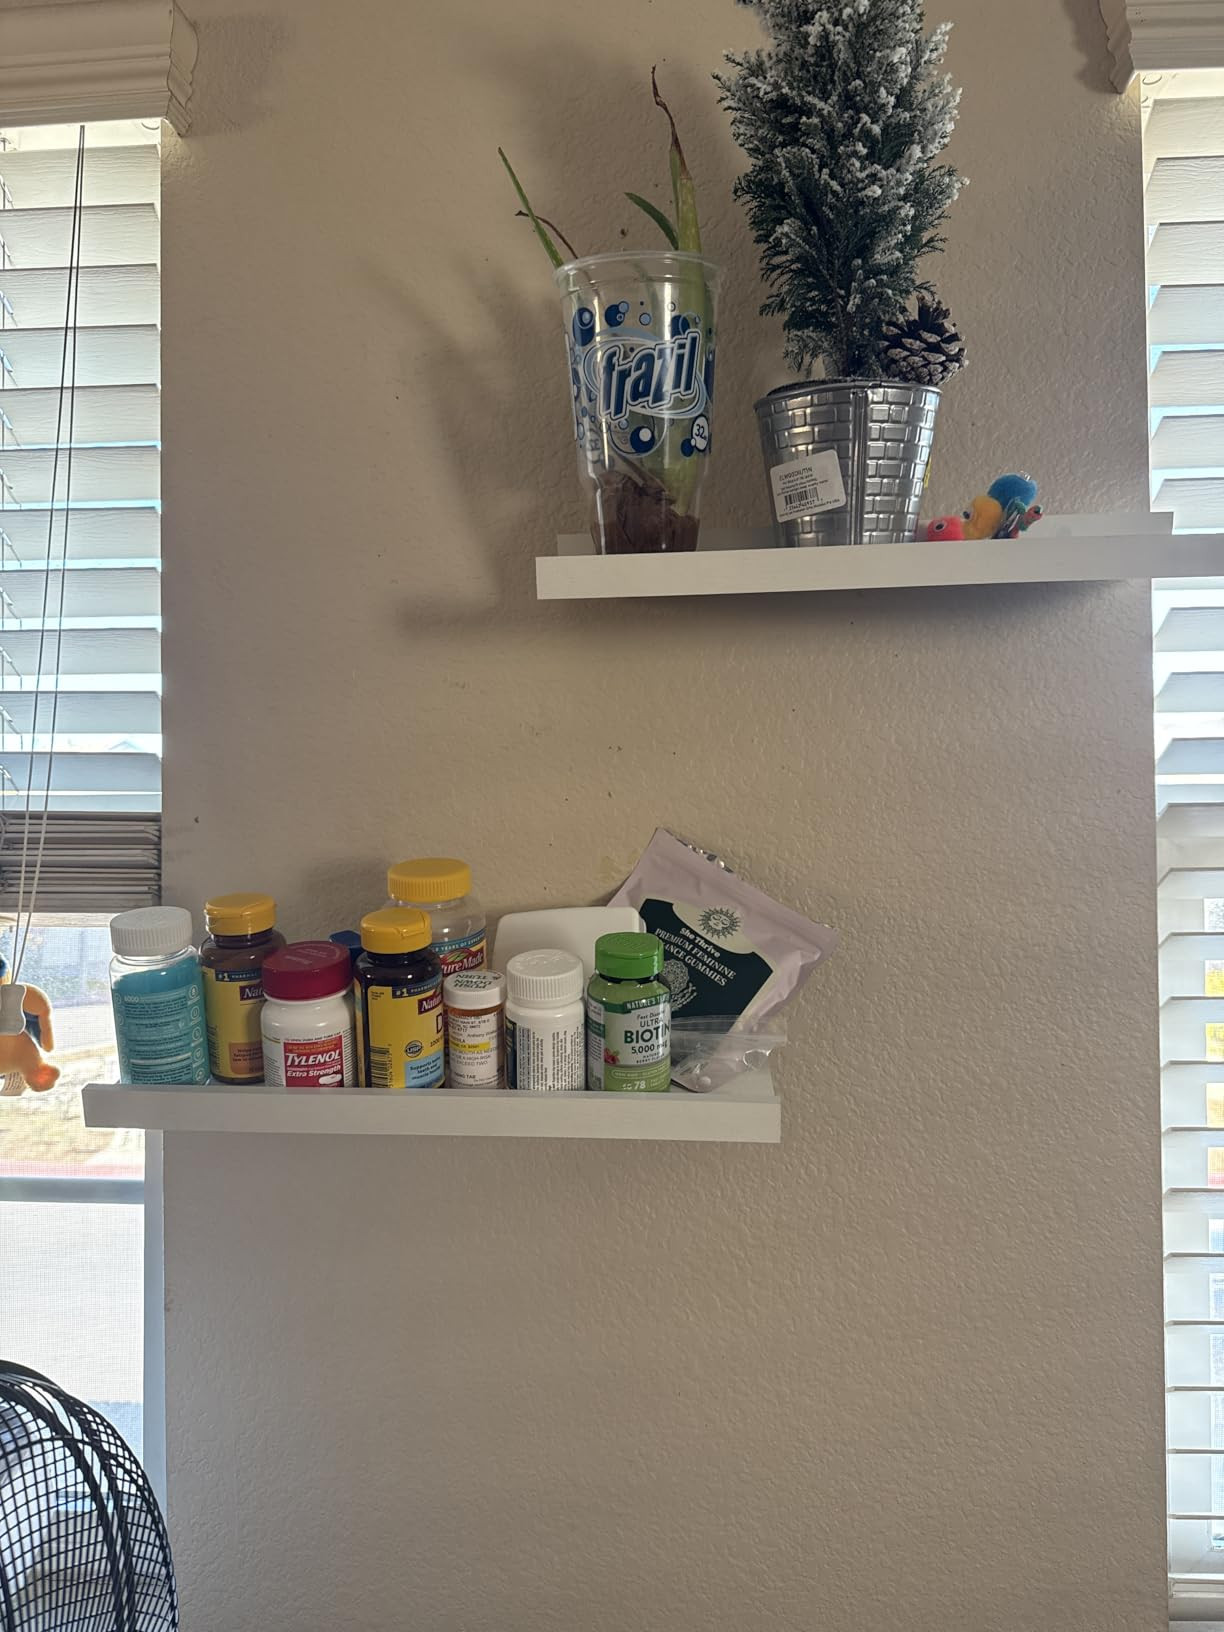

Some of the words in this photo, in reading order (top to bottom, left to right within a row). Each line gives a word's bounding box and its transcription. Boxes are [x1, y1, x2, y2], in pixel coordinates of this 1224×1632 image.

[599, 331, 700, 421] frazil
[695, 424, 705, 438] 32
[680, 928, 695, 940] She
[695, 936, 721, 958] Thrive
[655, 928, 694, 954] PREMIUM
[693, 948, 737, 980] FEMININE
[685, 955, 728, 987] GUMMIES
[624, 1023, 670, 1044] BIOTIN
[285, 1048, 341, 1066] TYLENOL
[308, 1065, 341, 1077] Strength
[634, 1080, 646, 1090] 78
